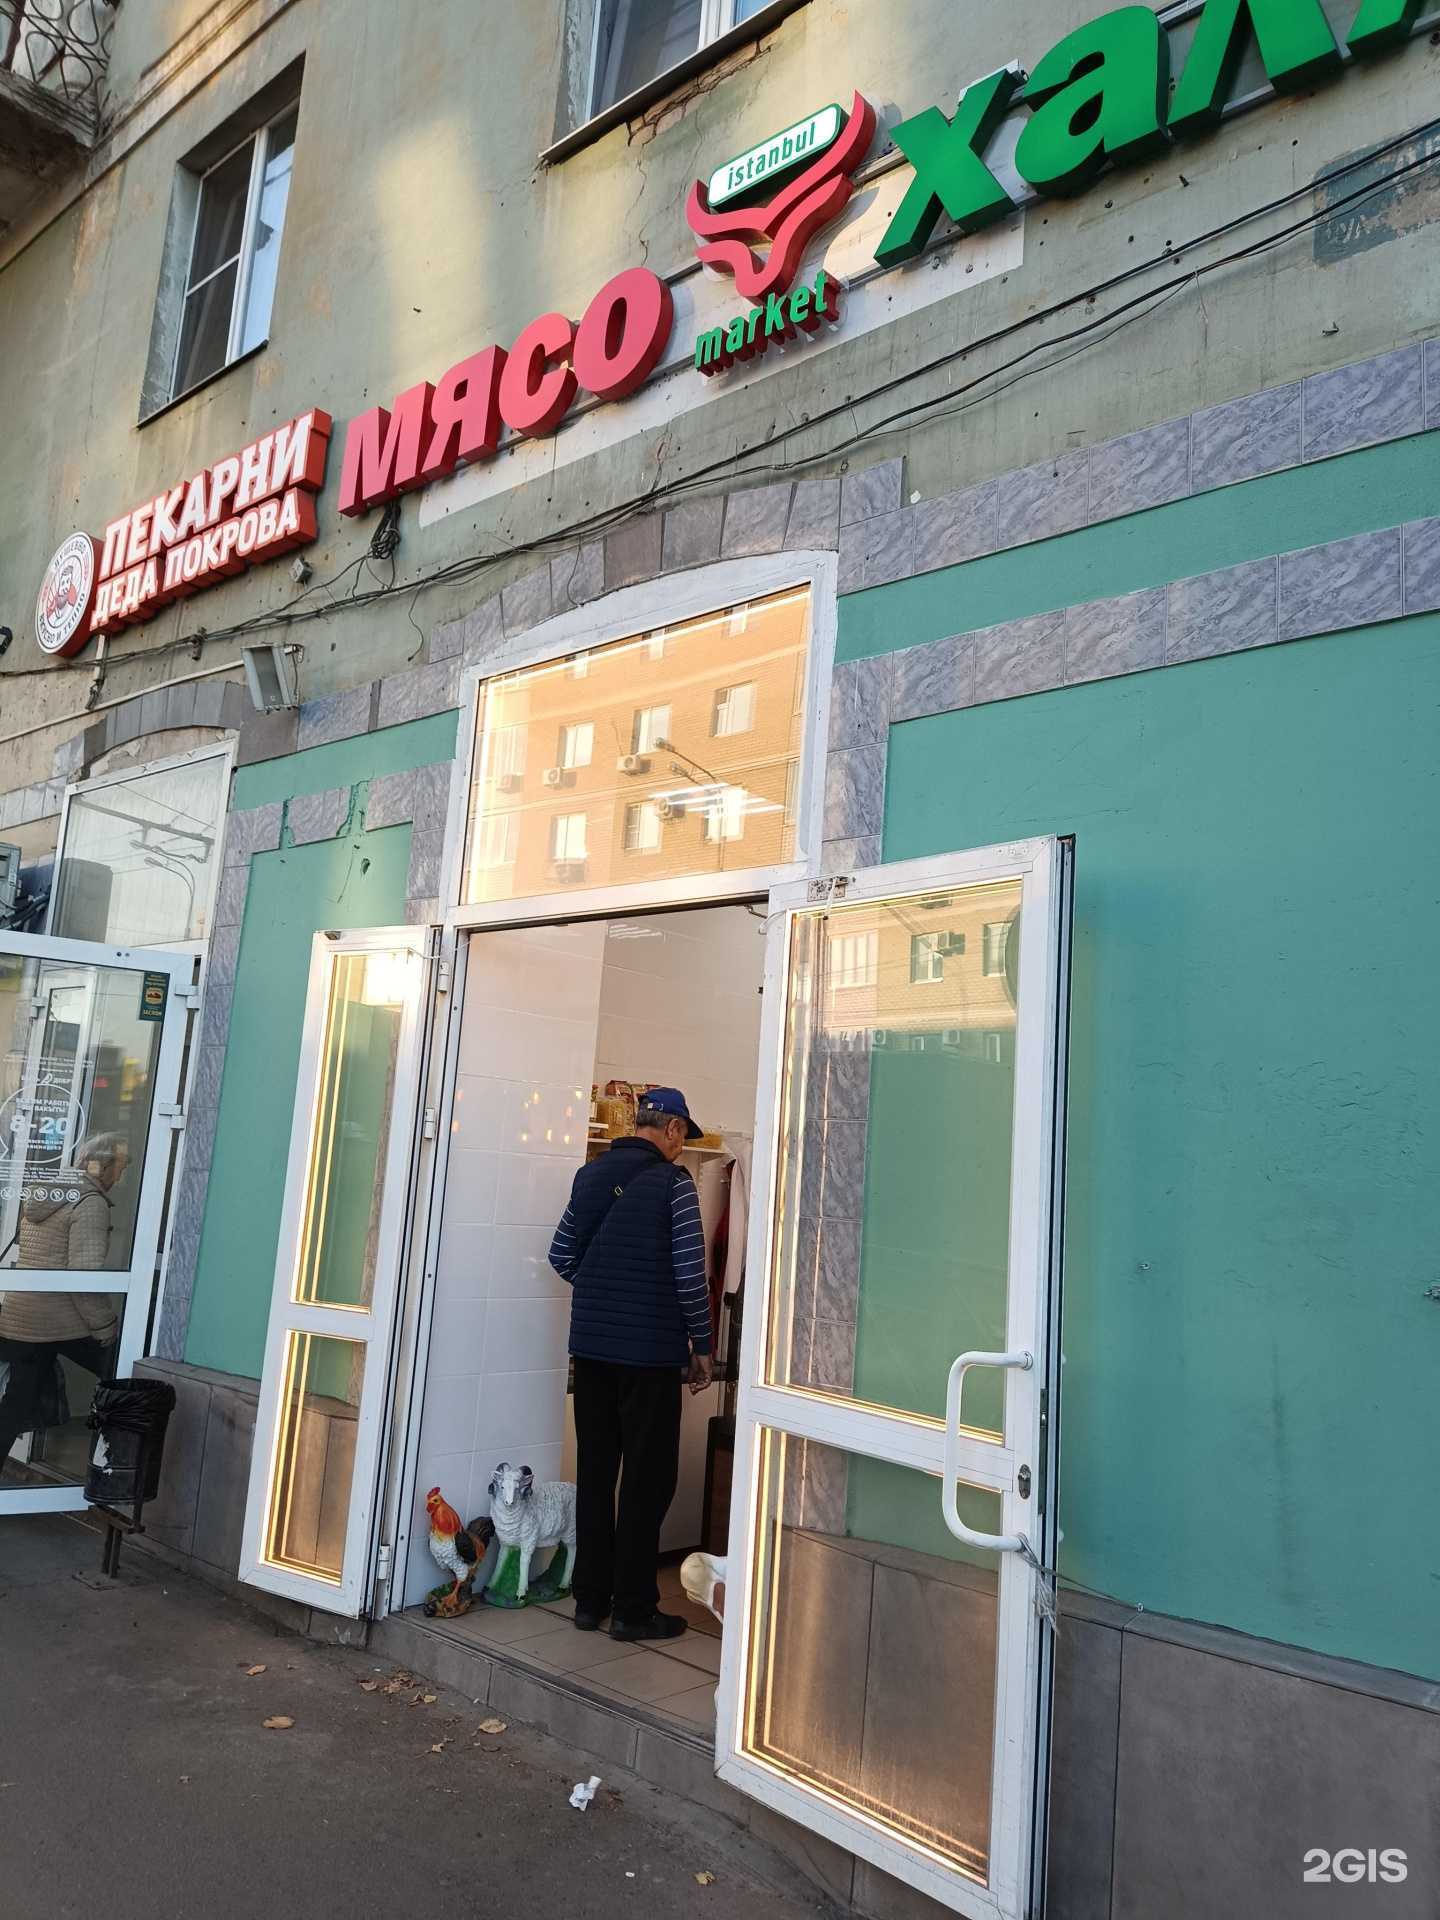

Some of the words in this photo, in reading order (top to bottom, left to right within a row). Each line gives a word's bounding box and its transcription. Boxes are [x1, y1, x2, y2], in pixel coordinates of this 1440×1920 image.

[727, 121, 817, 191] istanbul
[873, 0, 1408, 266] хал
[694, 271, 829, 370] market
[98, 412, 315, 582] ПЕКАРНИ
[91, 557, 158, 631] ДЕДА
[163, 489, 300, 591] ПОКРОВА
[39, 1116, 70, 1135] 20
